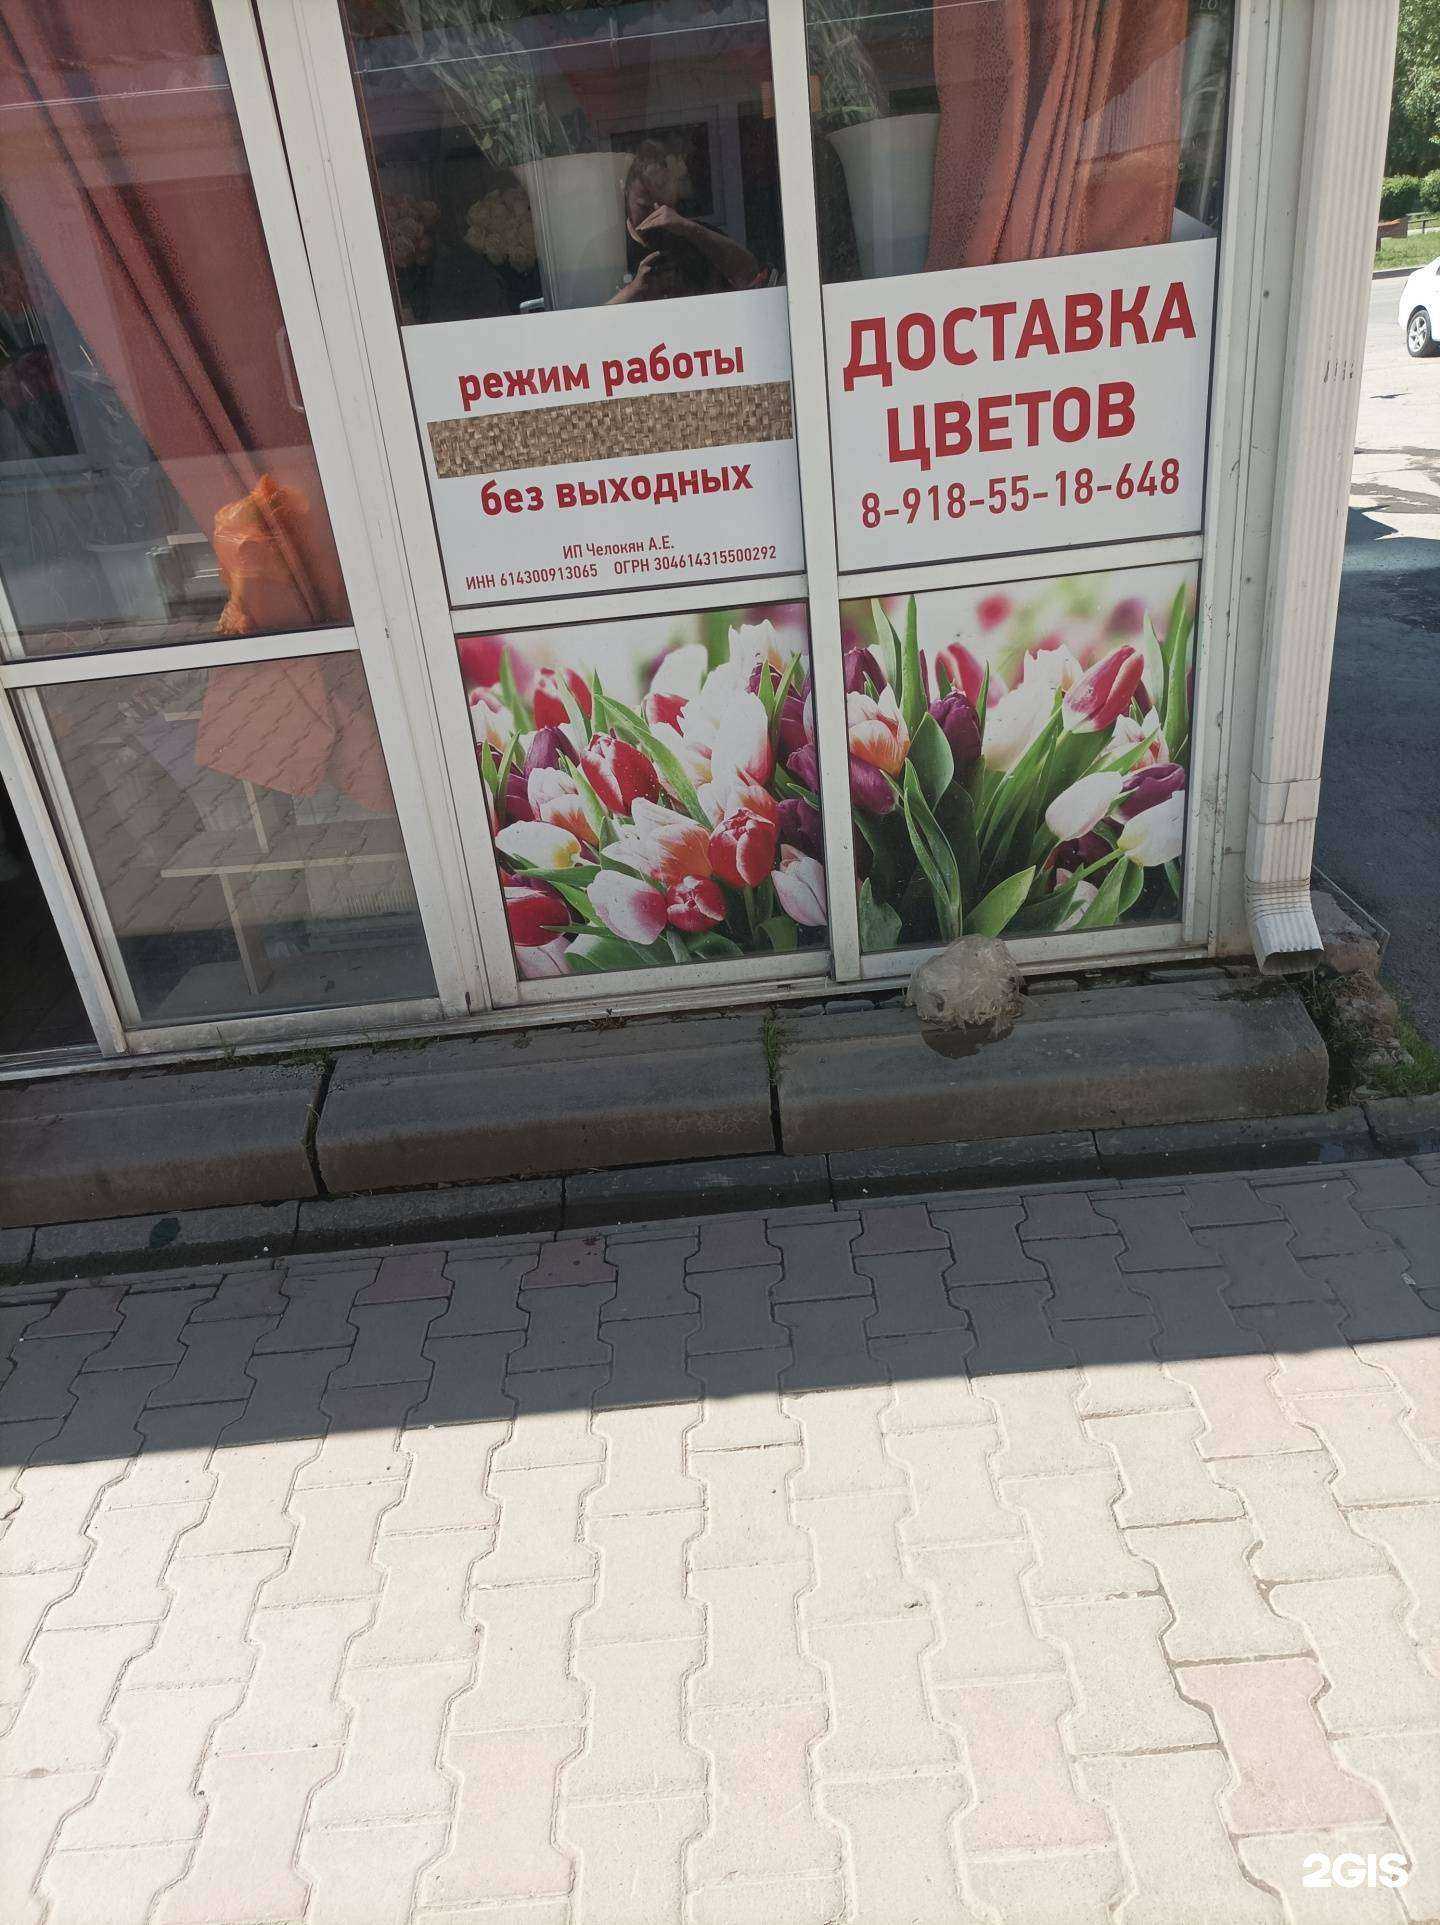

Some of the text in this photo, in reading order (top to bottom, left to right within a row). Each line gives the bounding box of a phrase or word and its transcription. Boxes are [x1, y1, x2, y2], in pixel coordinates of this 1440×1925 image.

[843, 281, 1197, 391] ДОСТАВКА
[458, 343, 744, 411] режим работы
[886, 381, 1136, 472] ЦВЕТОВ
[480, 464, 753, 516] без выходных
[861, 458, 1181, 528] 8-918-55-18-648
[465, 545, 777, 590] ИНН 614300913065 ОГРН 304614315500292
[563, 535, 674, 559] ИП Челокян А.Е.
